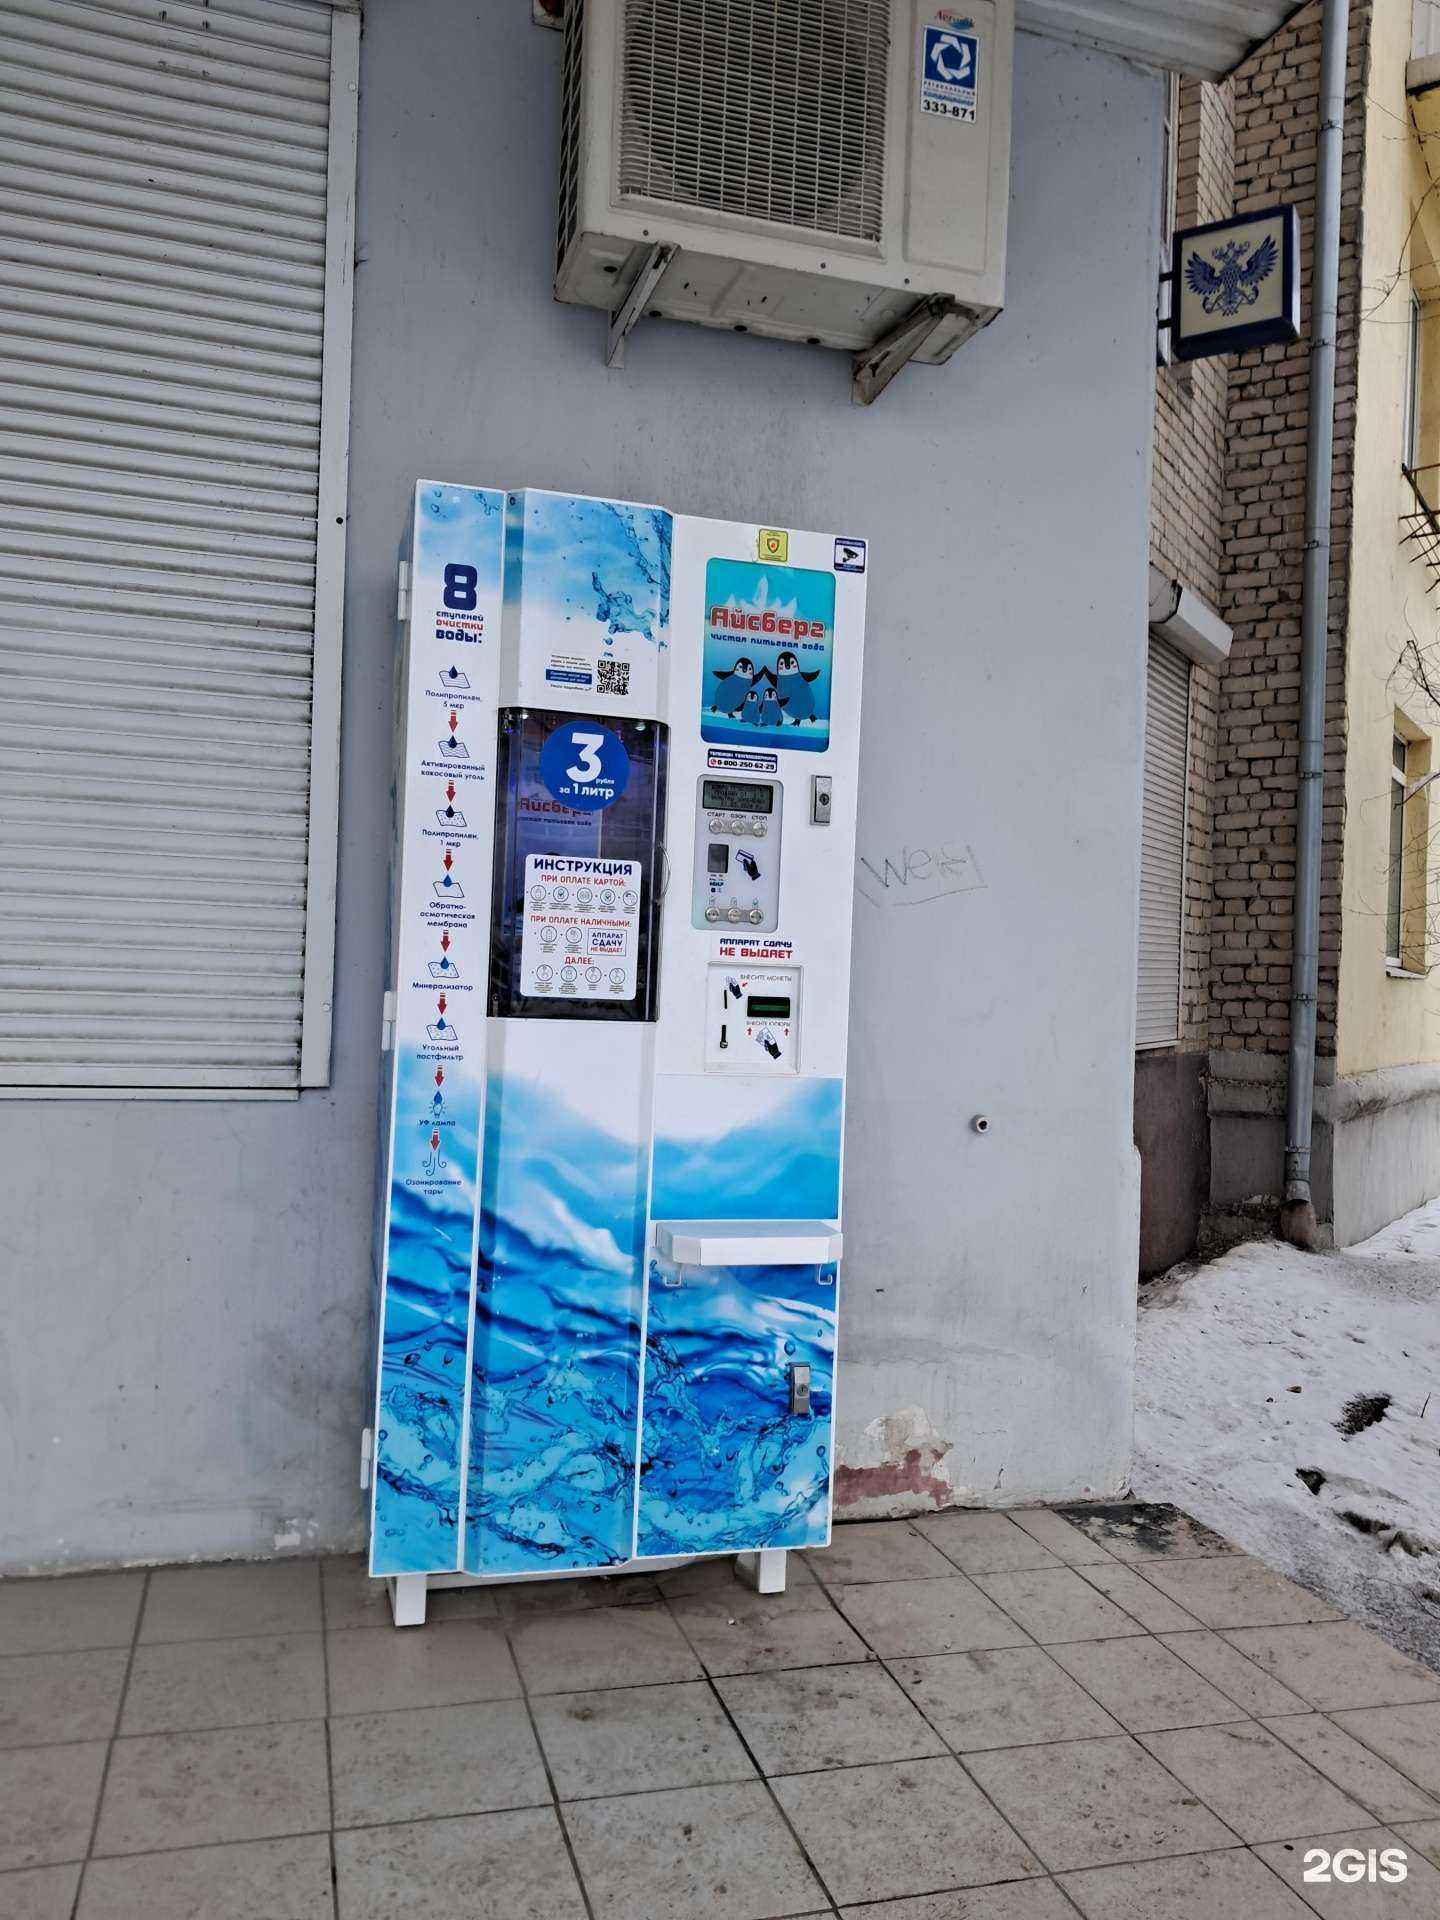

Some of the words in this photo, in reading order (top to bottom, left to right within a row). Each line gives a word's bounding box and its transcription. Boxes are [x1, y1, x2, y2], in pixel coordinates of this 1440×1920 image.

[923, 100, 975, 120] 333-871
[444, 564, 477, 611] 8
[436, 611, 483, 621] ступеней
[436, 619, 483, 630] очистки
[711, 607, 824, 640] Айсберг
[436, 630, 482, 643] воды:
[711, 634, 747, 642] чистая
[751, 638, 798, 648] питьевая
[802, 642, 824, 651] вода
[566, 732, 604, 783] 3
[421, 760, 485, 771] Активированный
[421, 770, 462, 778] кокосовый
[573, 784, 578, 794] 1
[581, 787, 614, 799] литр
[535, 859, 632, 875] ИНСТРУКЦИЯ
[560, 876, 591, 884] ОПЛАТЕ
[420, 912, 475, 920] осмотическая
[549, 916, 578, 924] ОПЛАТЕ
[592, 939, 622, 947] СДАЧУ
[720, 938, 760, 946] АППАРАТ
[764, 940, 792, 948] СДАЧУ
[720, 948, 735, 956] НЕ
[741, 948, 793, 958] ВЫДАЕТ
[412, 982, 473, 991] Минерализатор
[416, 1053, 464, 1061] постфильтр
